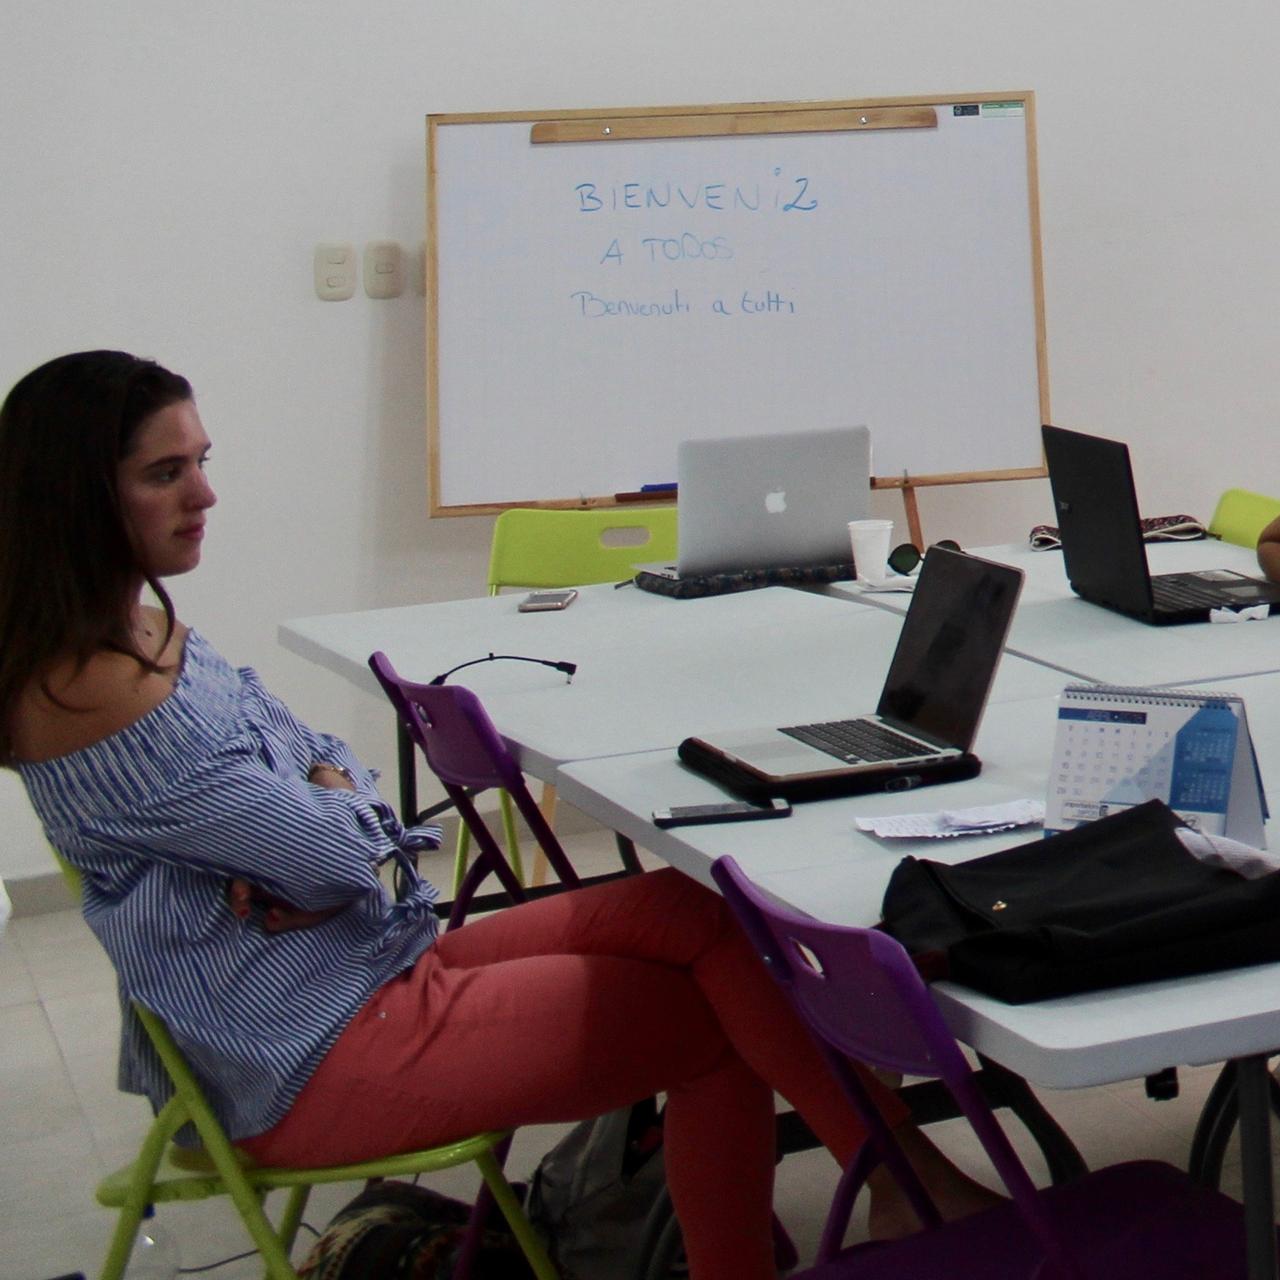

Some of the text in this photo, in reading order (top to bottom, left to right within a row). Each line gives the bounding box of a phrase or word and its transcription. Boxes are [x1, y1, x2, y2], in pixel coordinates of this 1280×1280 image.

[600, 232, 734, 265] A TODOS
[712, 299, 732, 316] a
[740, 290, 796, 315] tutti
